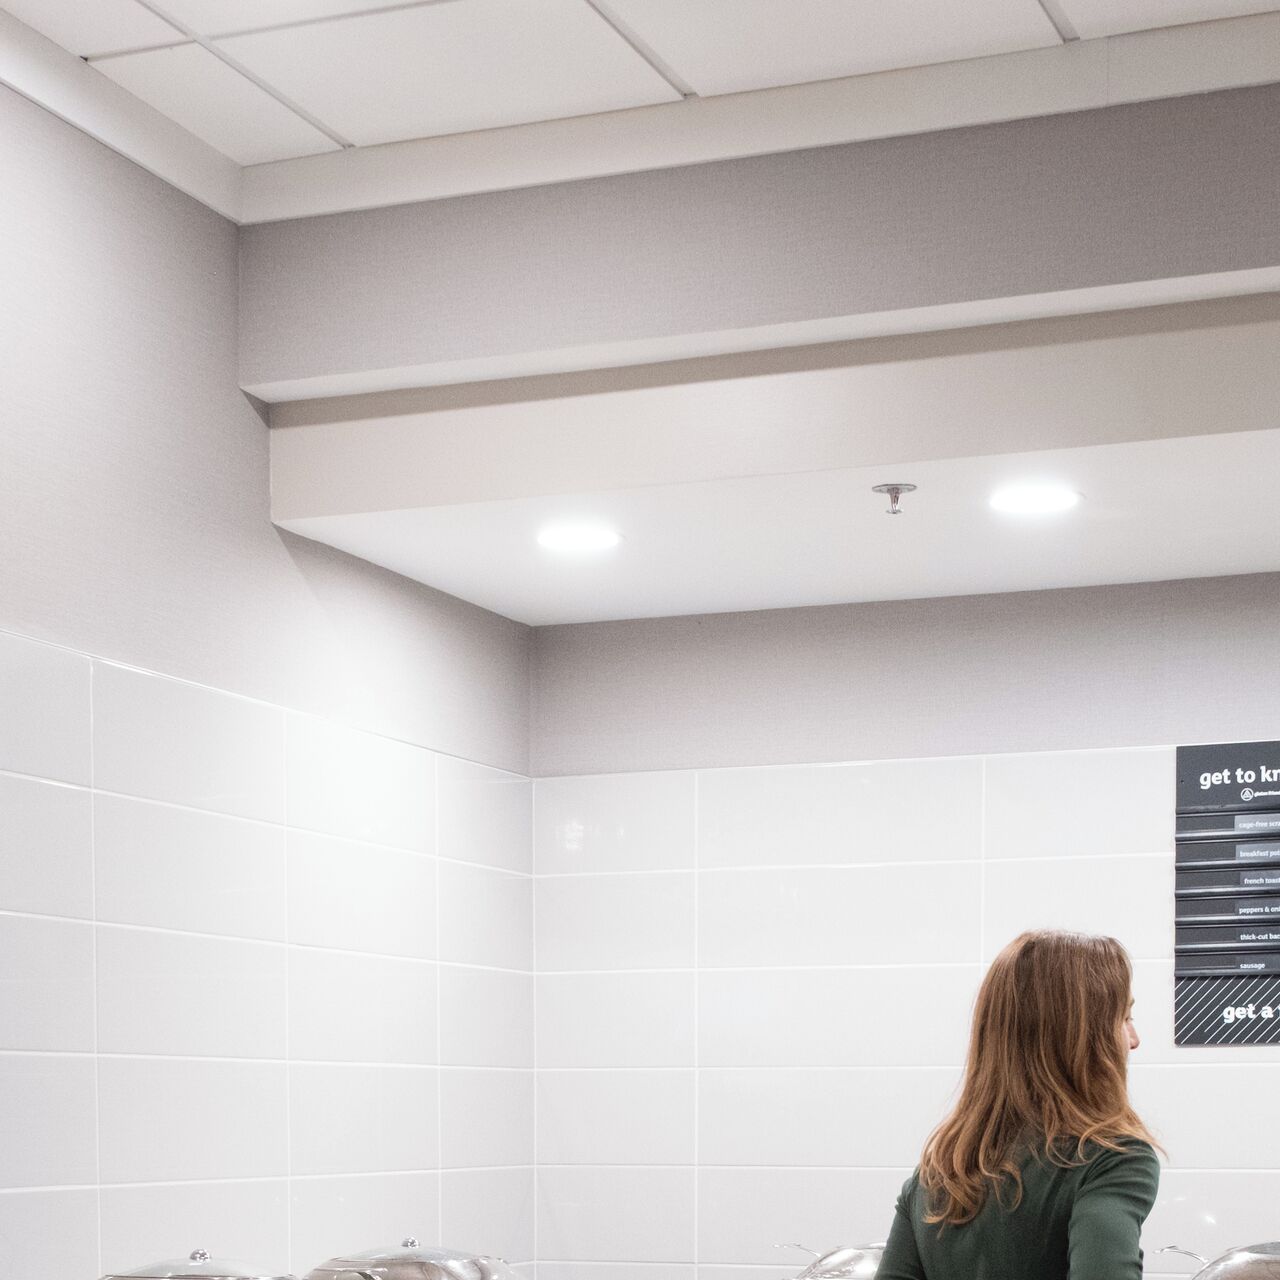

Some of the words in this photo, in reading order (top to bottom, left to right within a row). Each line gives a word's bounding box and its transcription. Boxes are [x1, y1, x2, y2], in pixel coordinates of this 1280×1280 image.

[1200, 768, 1231, 789] get
[1235, 768, 1256, 784] to
[1239, 906, 1263, 914] peppers
[1222, 1004, 1256, 1023] get
[1261, 1005, 1274, 1019] a
